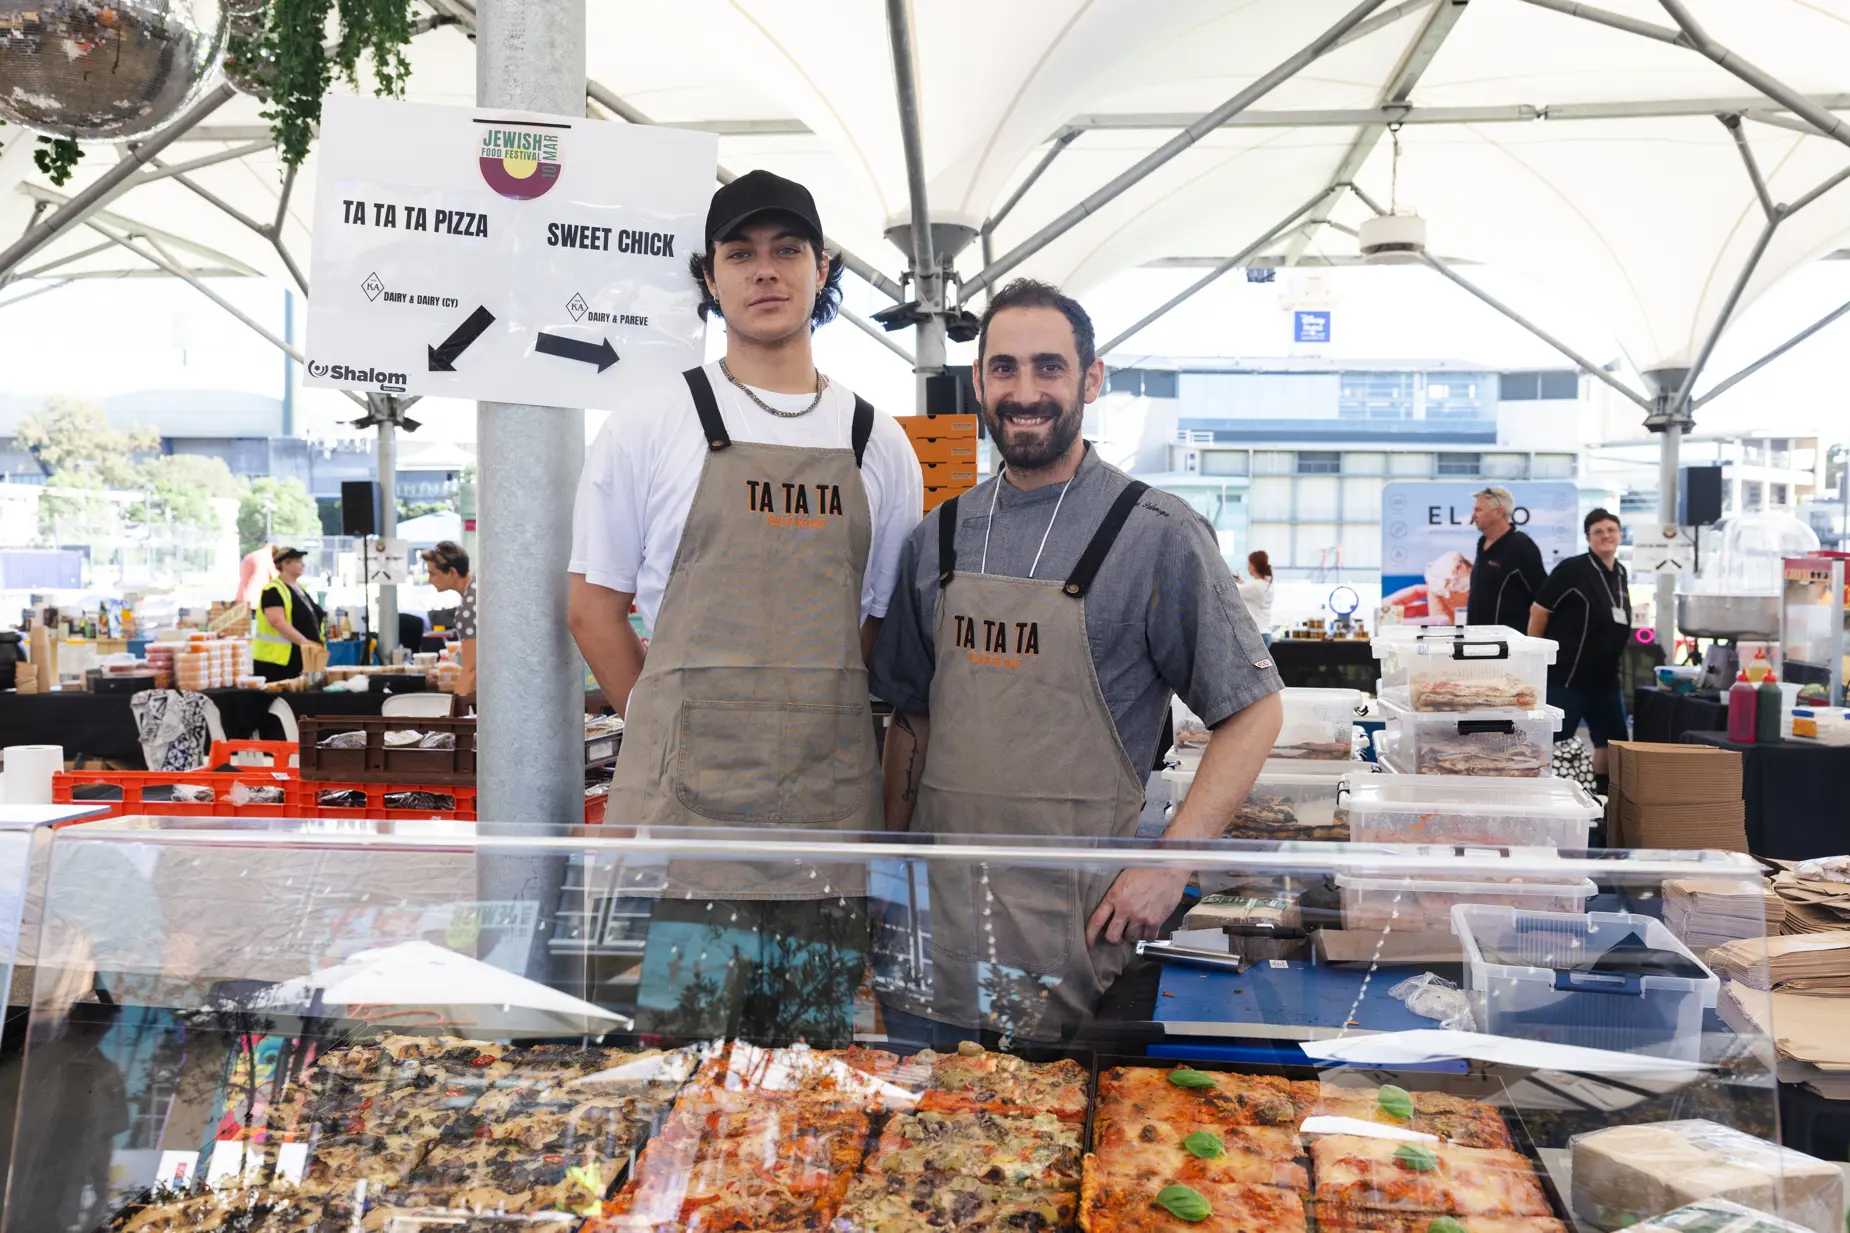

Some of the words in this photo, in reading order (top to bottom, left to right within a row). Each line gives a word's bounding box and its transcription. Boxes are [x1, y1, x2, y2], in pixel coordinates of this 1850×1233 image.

[483, 129, 542, 151] JEWISH
[542, 134, 558, 161] MAR
[481, 147, 502, 158] FOOD
[504, 149, 542, 162] FESTIVAL
[541, 165, 557, 178] 10
[343, 200, 366, 225] TA
[373, 203, 396, 228] TA
[404, 206, 427, 232] TA
[434, 209, 488, 238] PIZZA
[547, 222, 612, 251] SWEET
[618, 229, 675, 257] CHICK
[366, 282, 380, 292] KA
[383, 291, 407, 303] DAIRY
[409, 295, 415, 304] &
[417, 294, 440, 306] DAIRY
[442, 297, 459, 308] (CY)
[571, 303, 584, 312] KA
[588, 311, 611, 323] DAIRY
[612, 315, 618, 324] &
[620, 314, 649, 327] PAREVE
[330, 364, 407, 385] Shalom
[744, 480, 774, 514] TA
[781, 483, 809, 516] TA
[814, 484, 843, 516] TA
[1428, 506, 1530, 525] ELO
[953, 615, 976, 650] TA
[982, 620, 1007, 654] TA
[1013, 622, 1039, 656] TA
